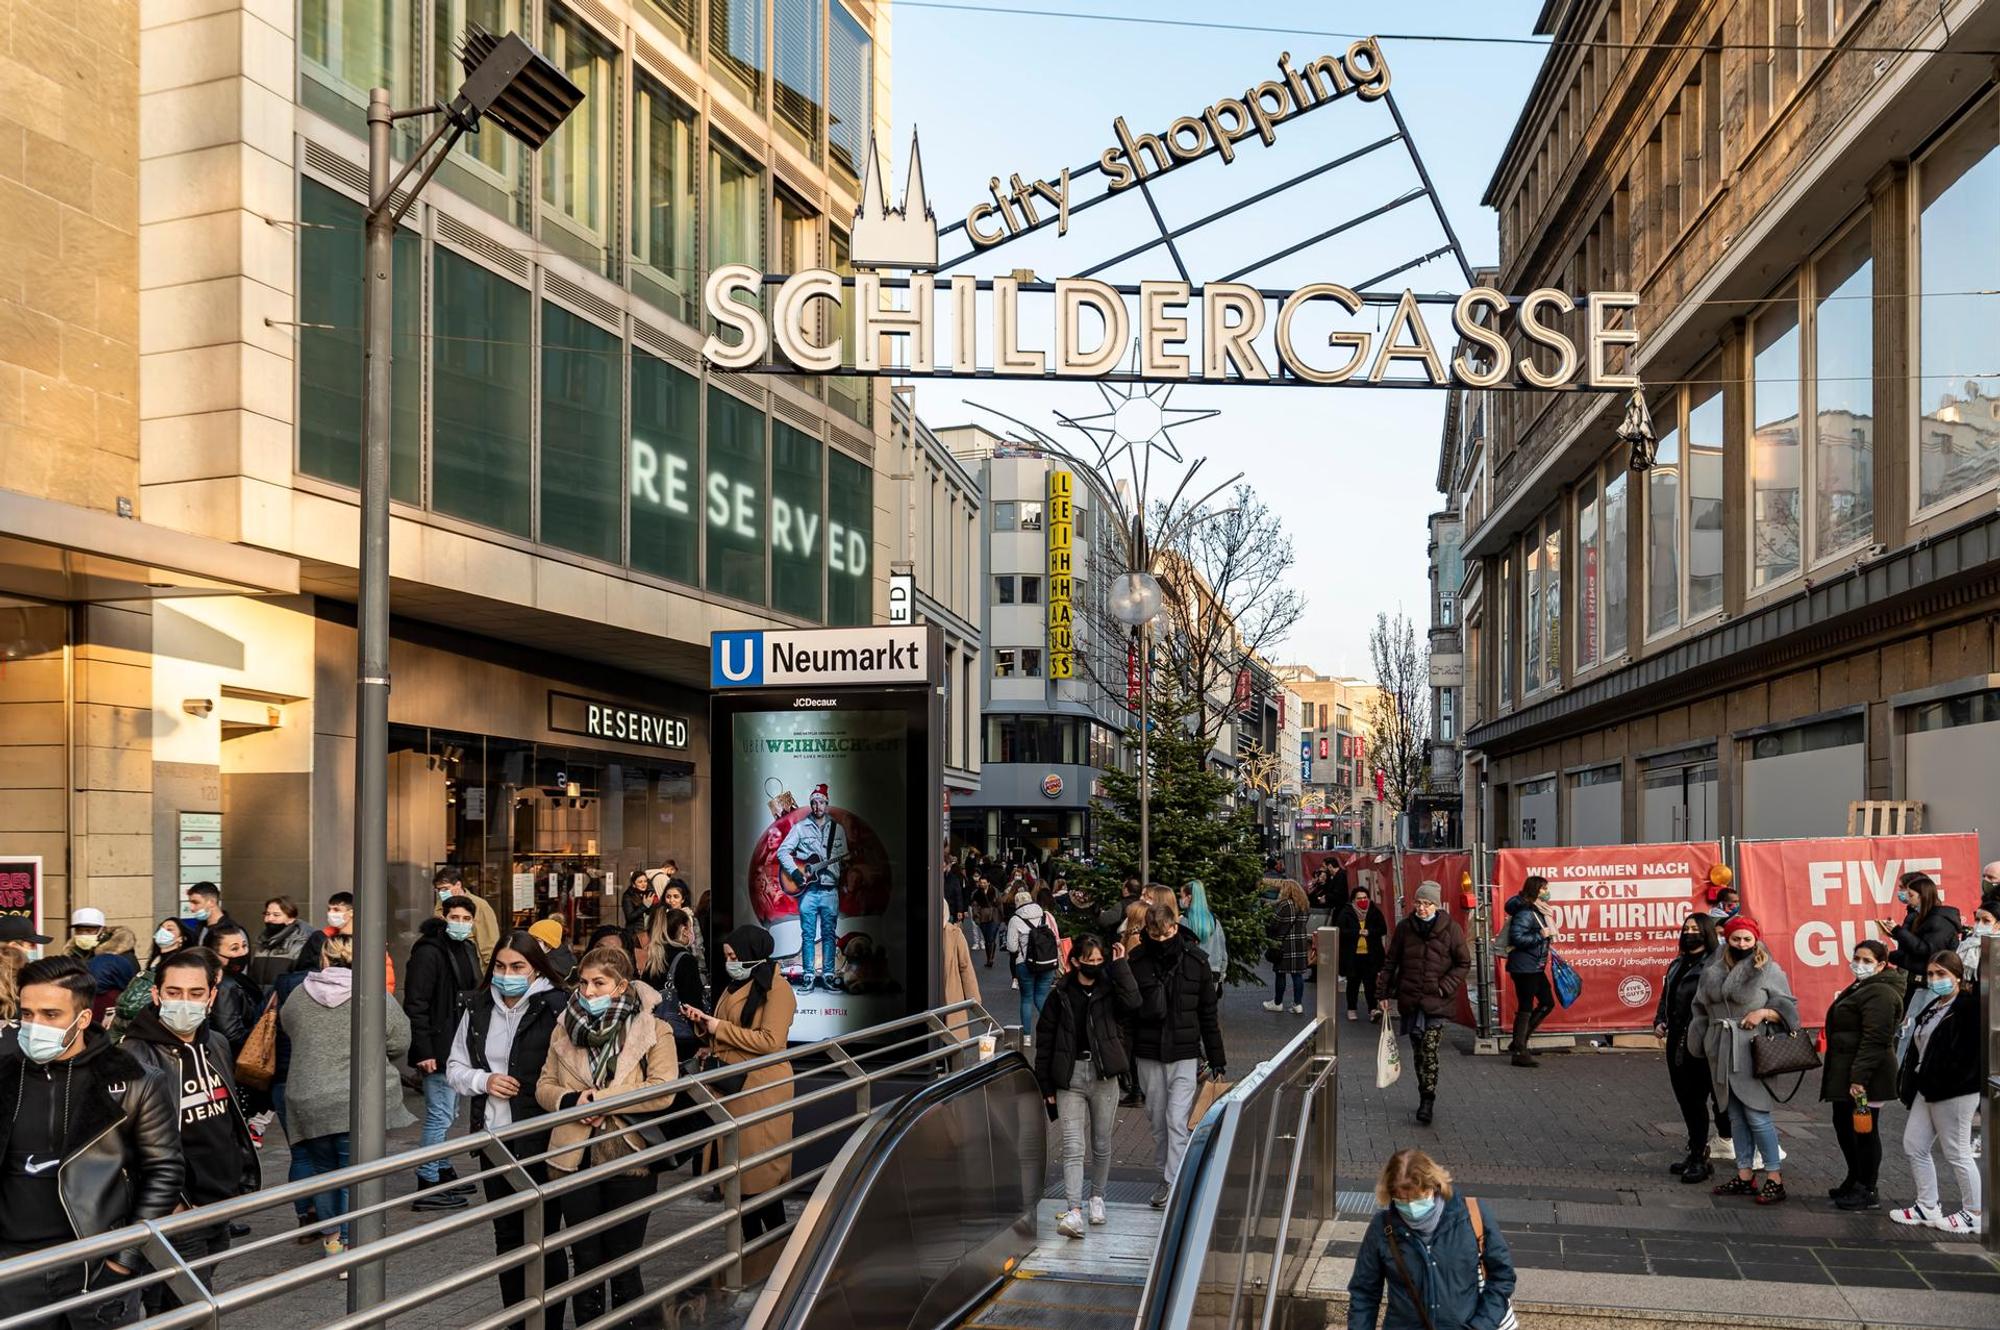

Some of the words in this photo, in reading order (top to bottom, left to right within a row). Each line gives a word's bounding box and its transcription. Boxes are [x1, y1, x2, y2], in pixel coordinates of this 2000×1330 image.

[965, 167, 1069, 249] city
[1099, 35, 1392, 192] shopping
[702, 263, 1640, 390] SCHILDERGASSE
[1060, 475, 1071, 676] LEIHHAUS
[721, 638, 754, 682] U
[771, 639, 920, 675] Neumarkt
[793, 697, 837, 708] JCDecaux
[588, 704, 687, 748] RESERVED
[1526, 866, 1558, 878] WIR
[1563, 864, 1638, 878] KOMMEN
[1643, 862, 1689, 875] NACH
[1580, 881, 1638, 899] KÖLN
[1551, 904, 1590, 930] OW
[1599, 901, 1693, 929] HIRING
[1579, 932, 1611, 942] TEIL
[1615, 931, 1642, 941] DES
[1646, 929, 1681, 940] TEAM
[1626, 989, 1645, 997] GUYS
[185, 1099, 228, 1124] JEAN
